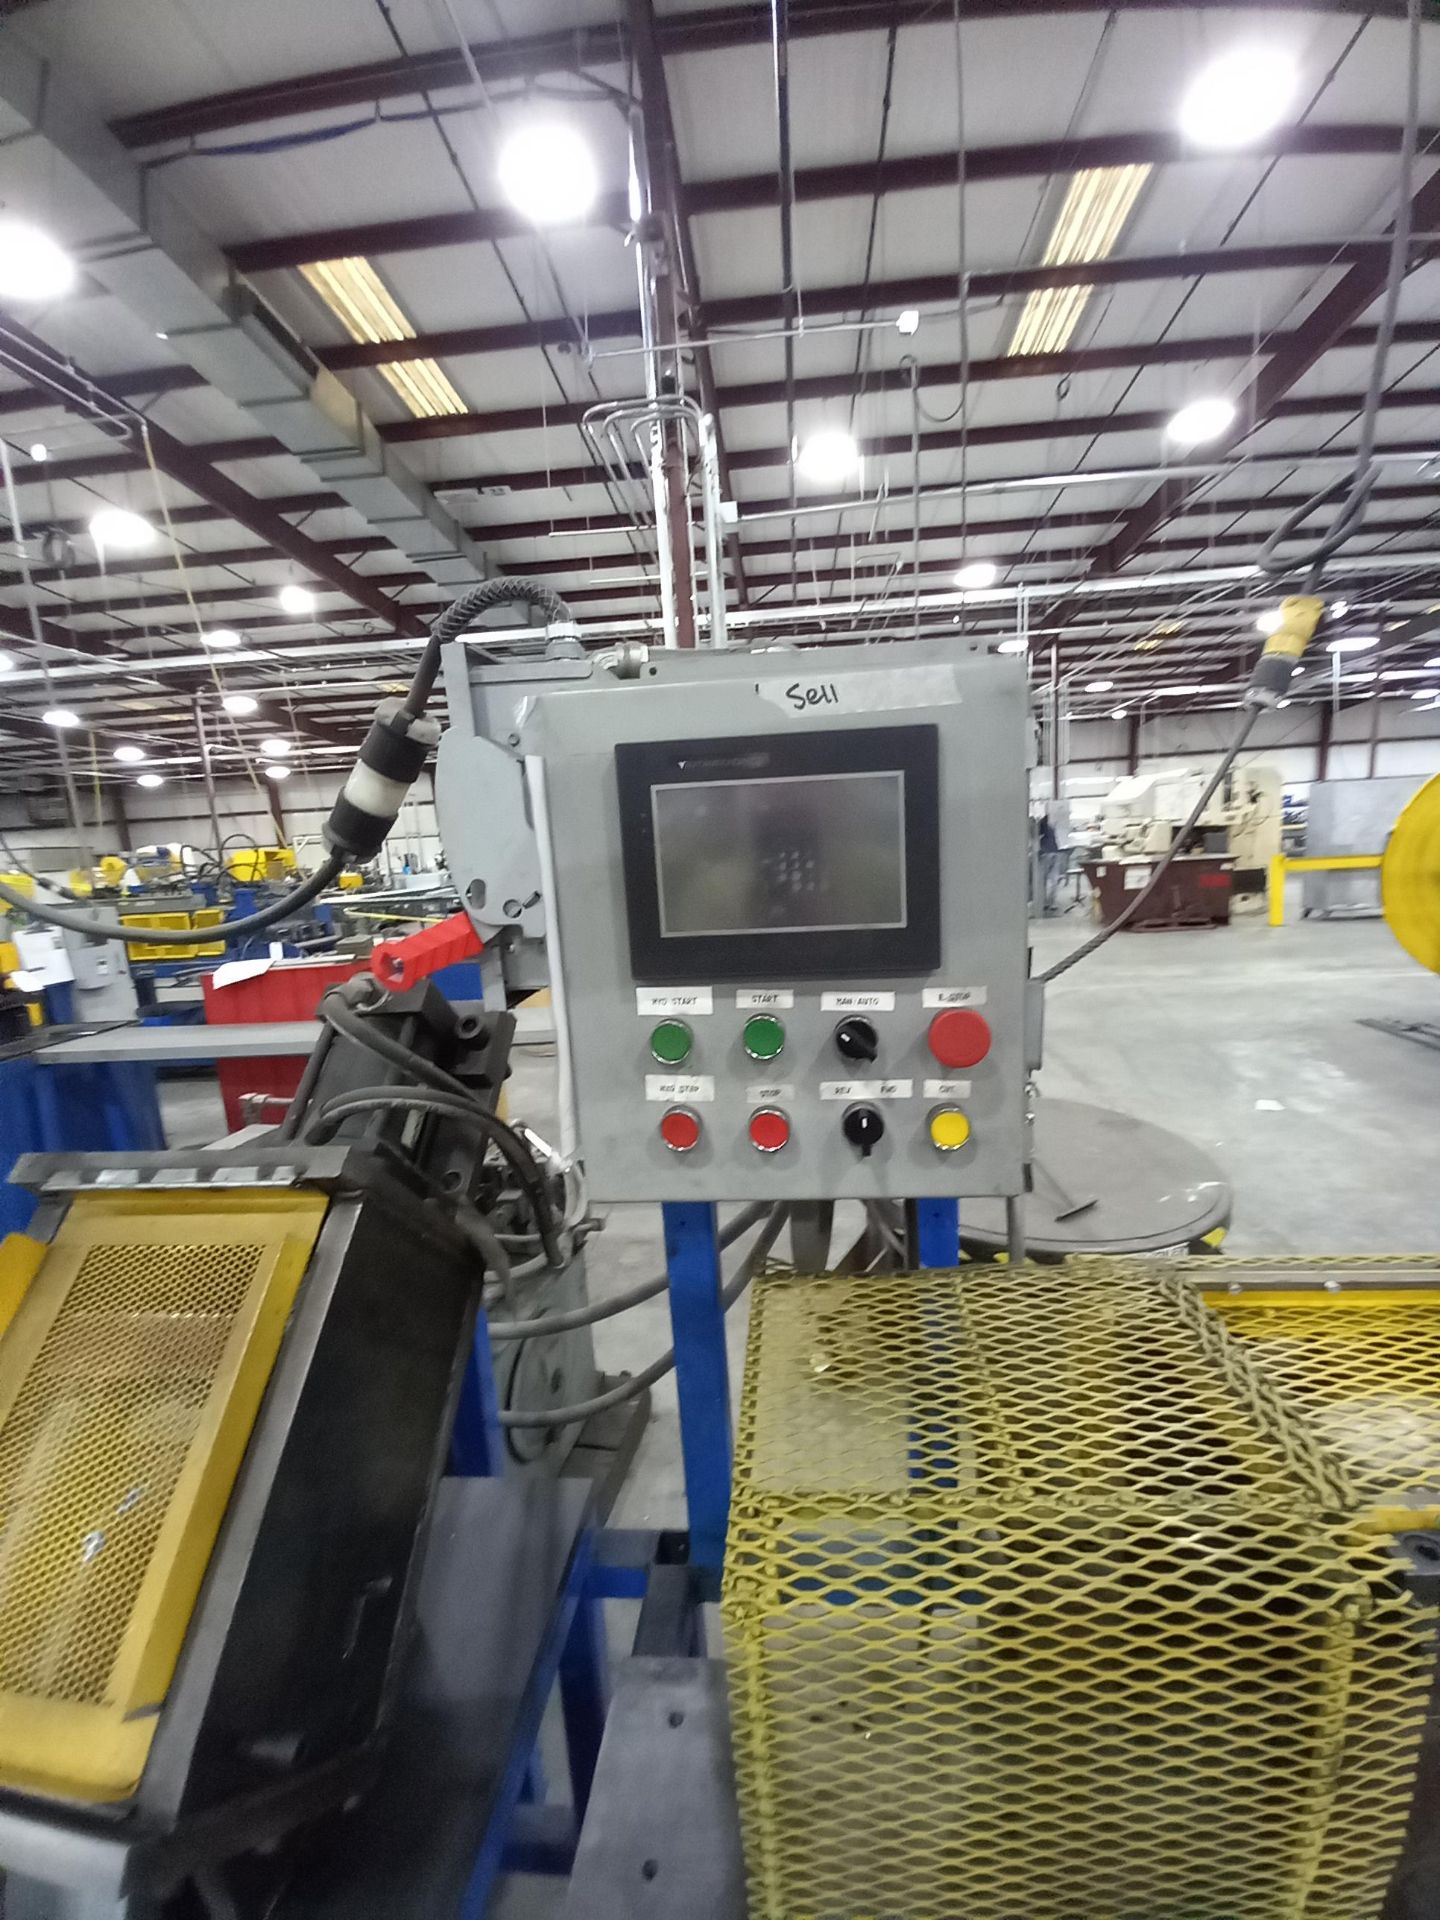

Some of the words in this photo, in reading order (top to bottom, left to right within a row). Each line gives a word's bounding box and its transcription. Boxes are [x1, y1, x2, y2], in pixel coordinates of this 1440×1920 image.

[785, 683, 838, 710] Sell
[671, 996, 698, 1006] START
[752, 994, 779, 1004] START
